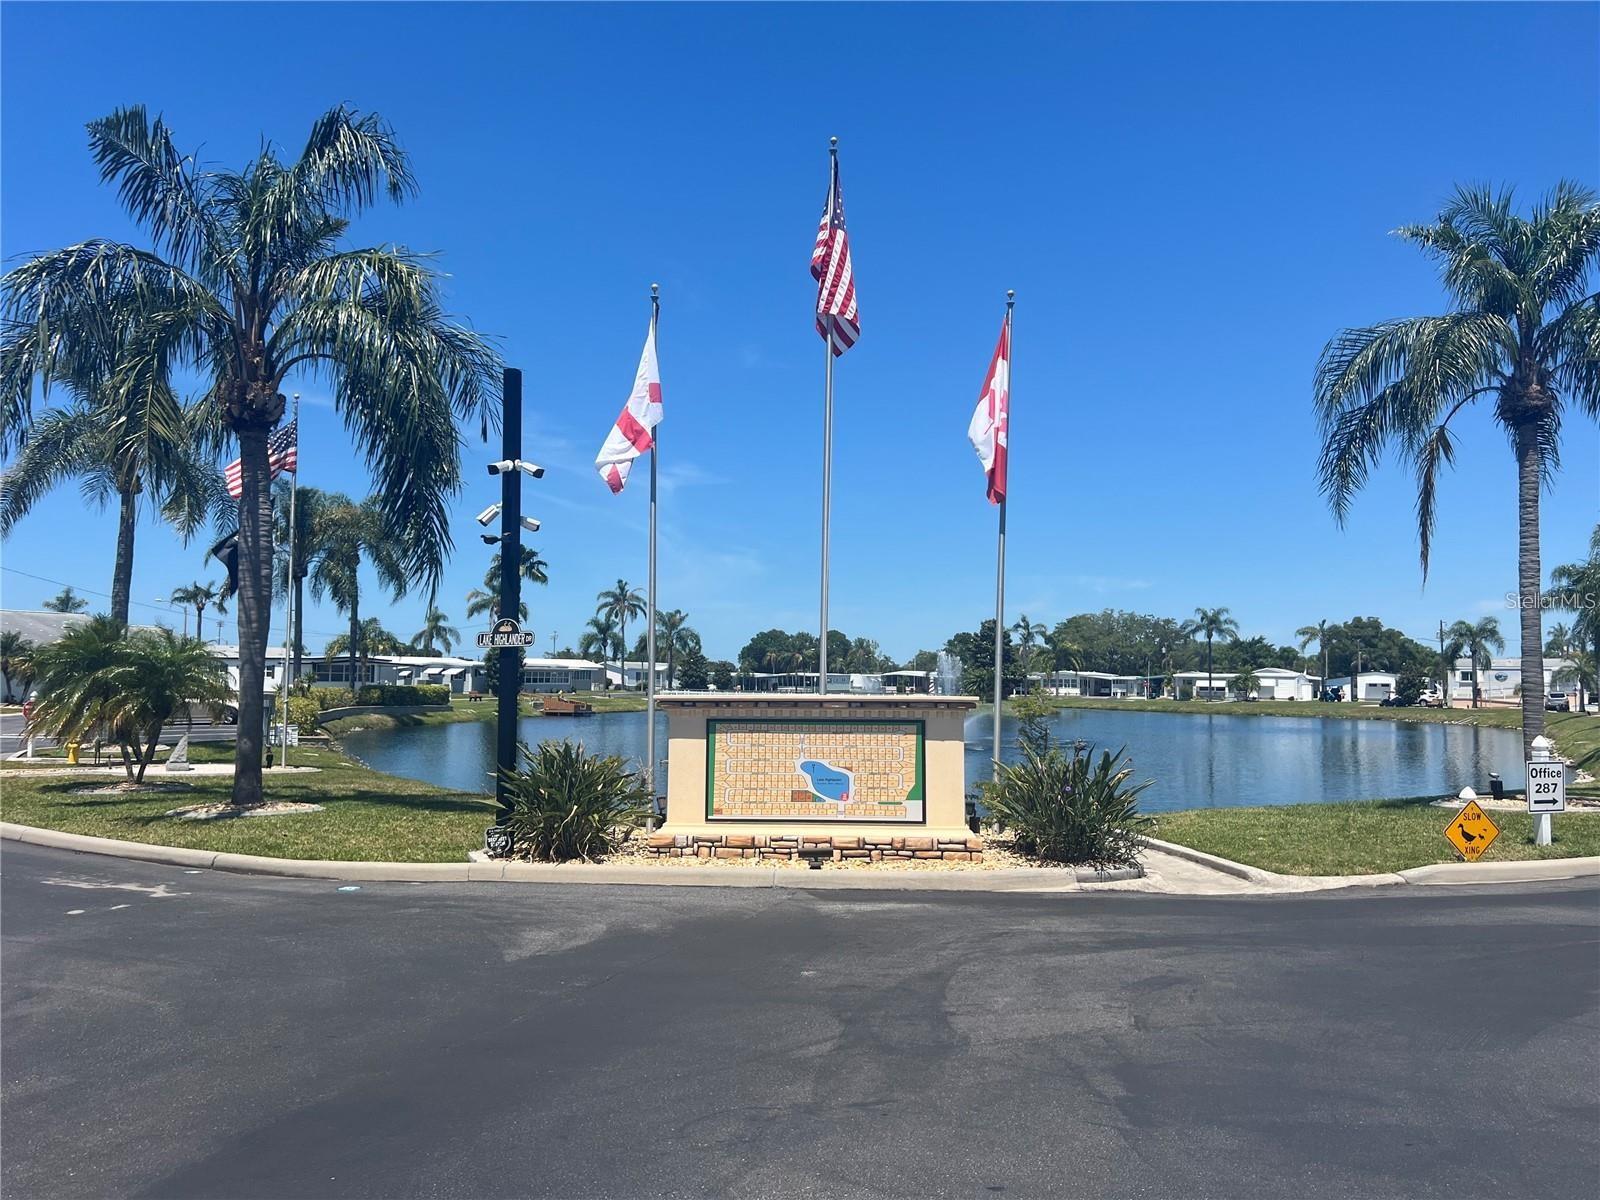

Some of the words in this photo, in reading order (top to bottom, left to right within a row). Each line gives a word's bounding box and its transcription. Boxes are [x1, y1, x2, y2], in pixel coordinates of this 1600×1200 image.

[479, 633, 493, 646] LAKE
[494, 633, 525, 645] HIGHLANDER
[1530, 767, 1562, 779] Office
[1535, 783, 1558, 794] 287
[1463, 812, 1482, 821] SLOW
[1464, 846, 1480, 855] XING
